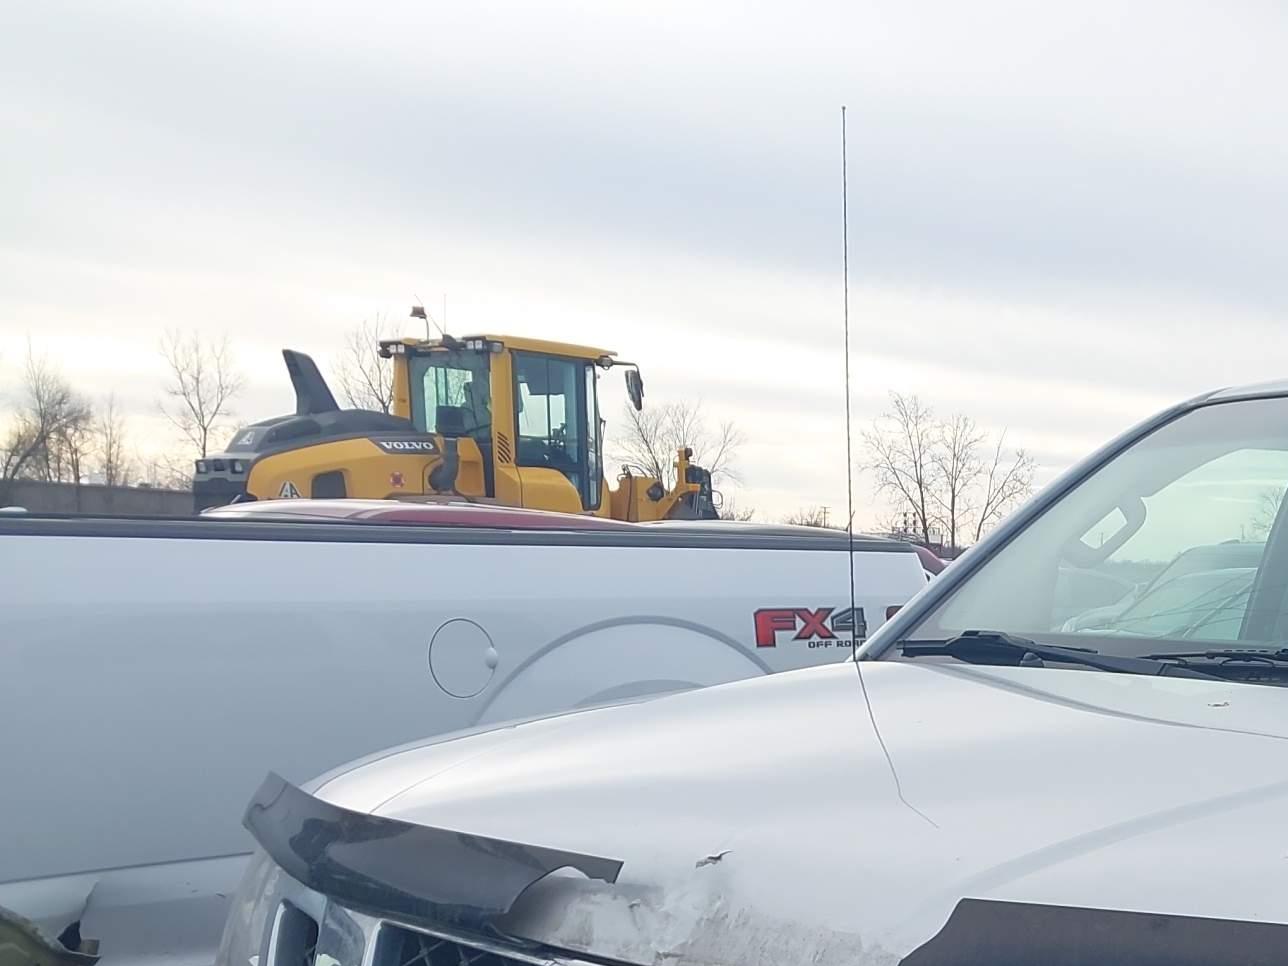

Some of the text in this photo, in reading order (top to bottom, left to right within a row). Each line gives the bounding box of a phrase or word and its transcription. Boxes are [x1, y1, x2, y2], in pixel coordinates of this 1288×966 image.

[380, 441, 434, 450] VOLVO
[753, 607, 867, 648] FX4
[808, 640, 832, 648] OFF
